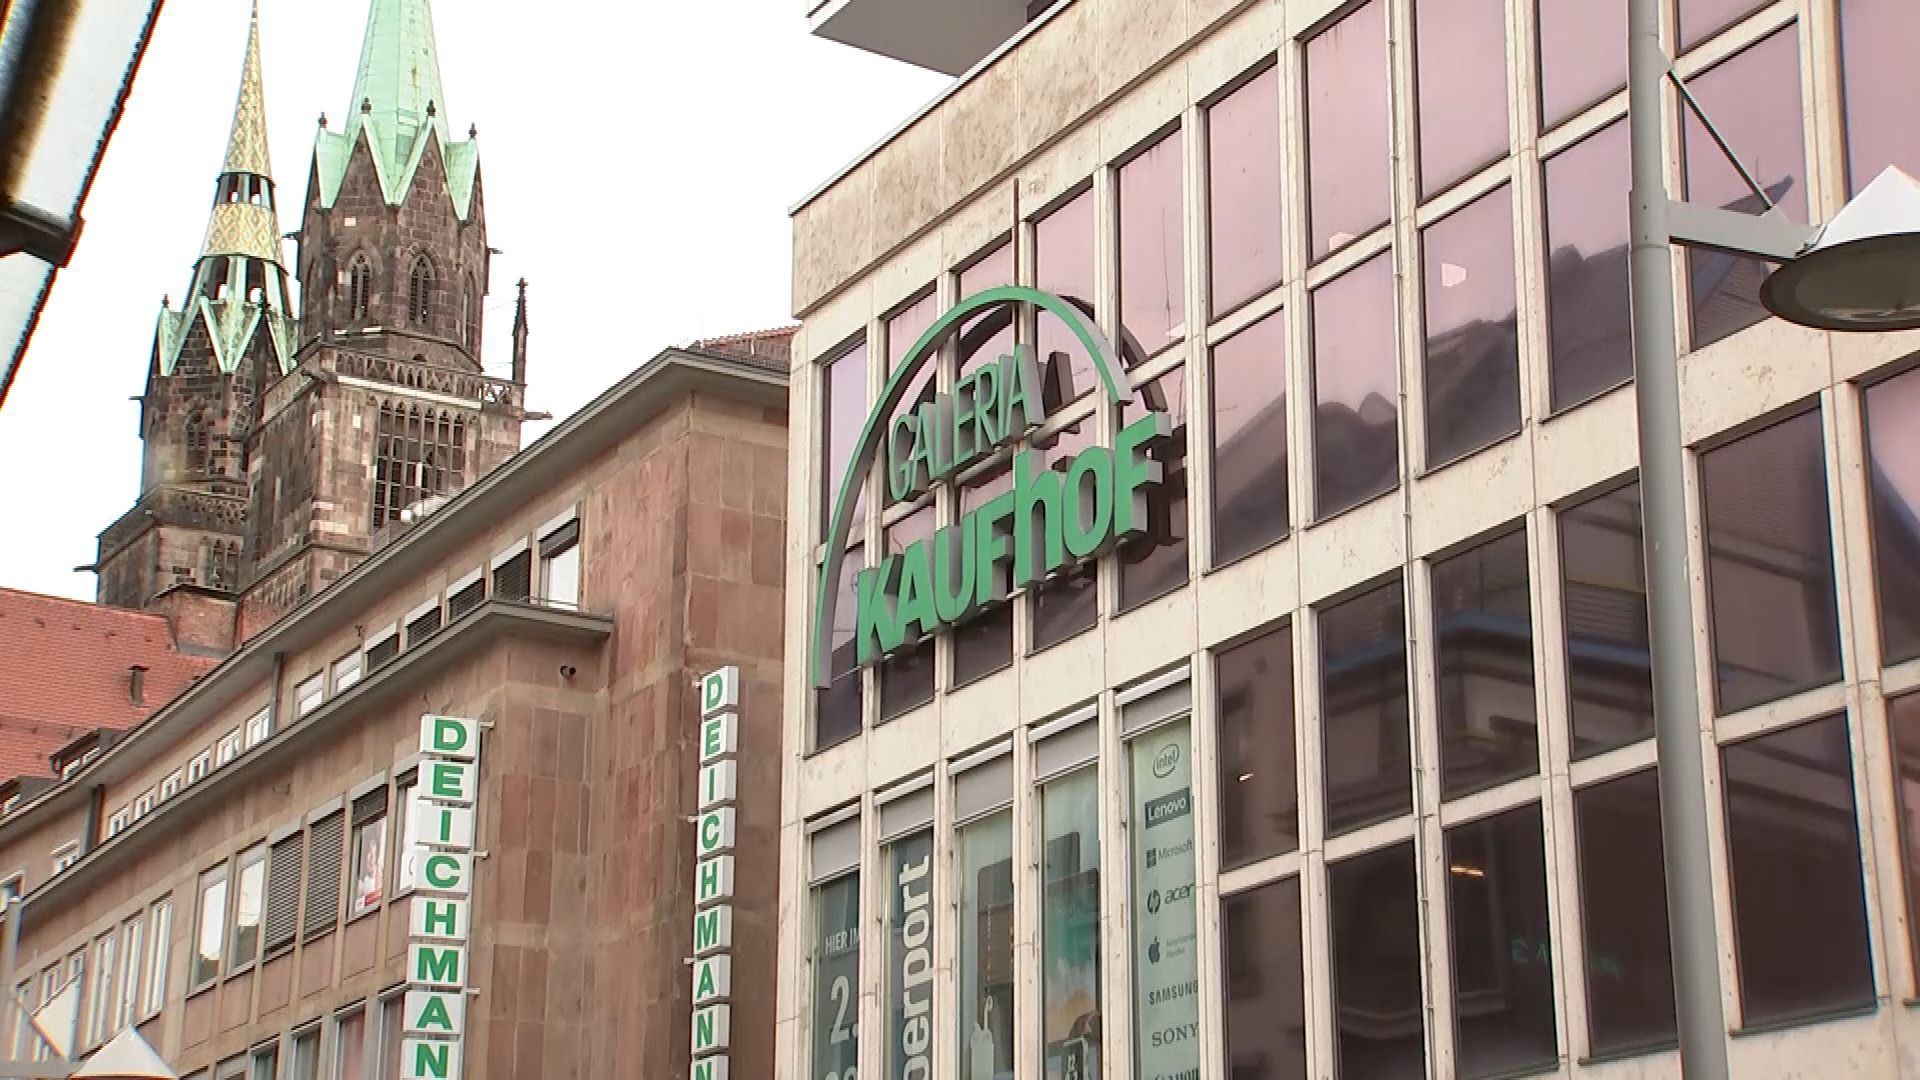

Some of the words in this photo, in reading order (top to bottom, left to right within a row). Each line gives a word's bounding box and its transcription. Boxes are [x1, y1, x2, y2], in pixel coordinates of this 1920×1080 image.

[888, 343, 1040, 501] GALERIA
[1147, 797, 1188, 821] Lenovo
[1164, 881, 1195, 905] acer
[825, 930, 848, 955] HIER
[1151, 1021, 1199, 1048] SONY
